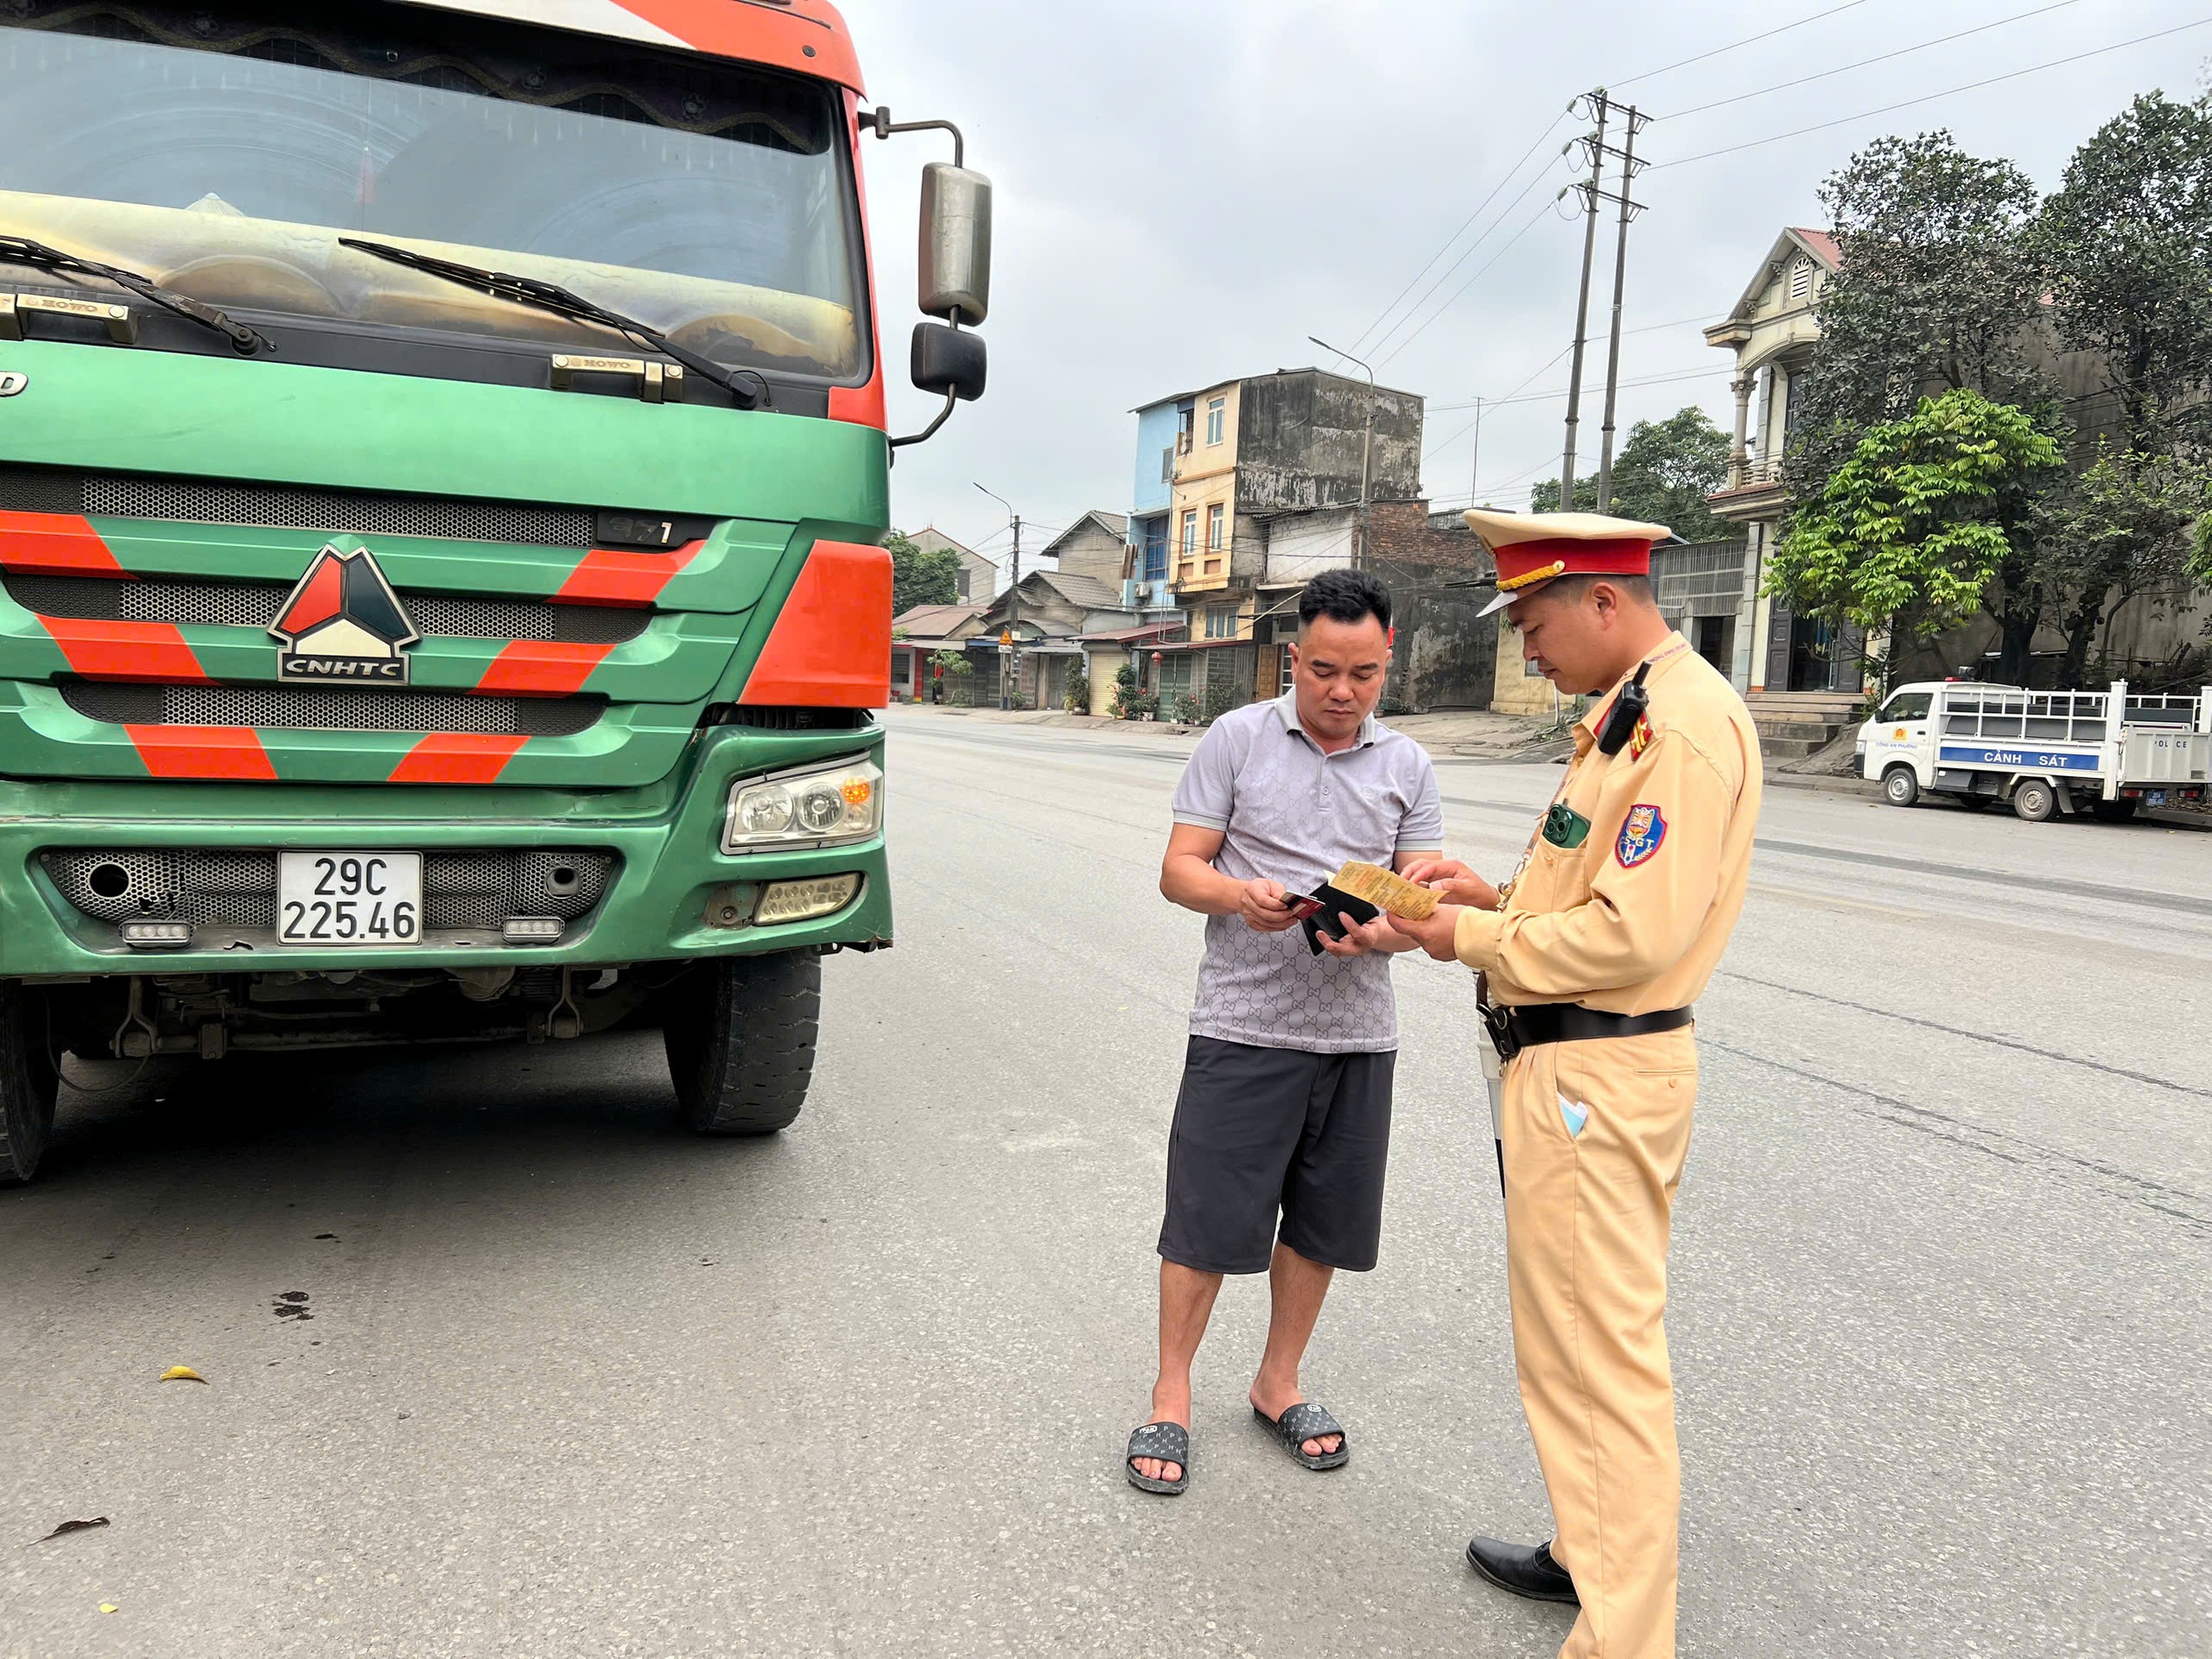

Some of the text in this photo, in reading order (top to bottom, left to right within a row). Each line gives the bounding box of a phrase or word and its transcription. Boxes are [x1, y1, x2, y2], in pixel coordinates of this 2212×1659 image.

[41, 299, 98, 312] HOWO
[584, 359, 630, 369] HOWO
[286, 659, 400, 677] CNHTC
[1984, 748, 2068, 767] CẢNH SÁT
[315, 858, 387, 895] 29C
[283, 901, 416, 938] 225.46
